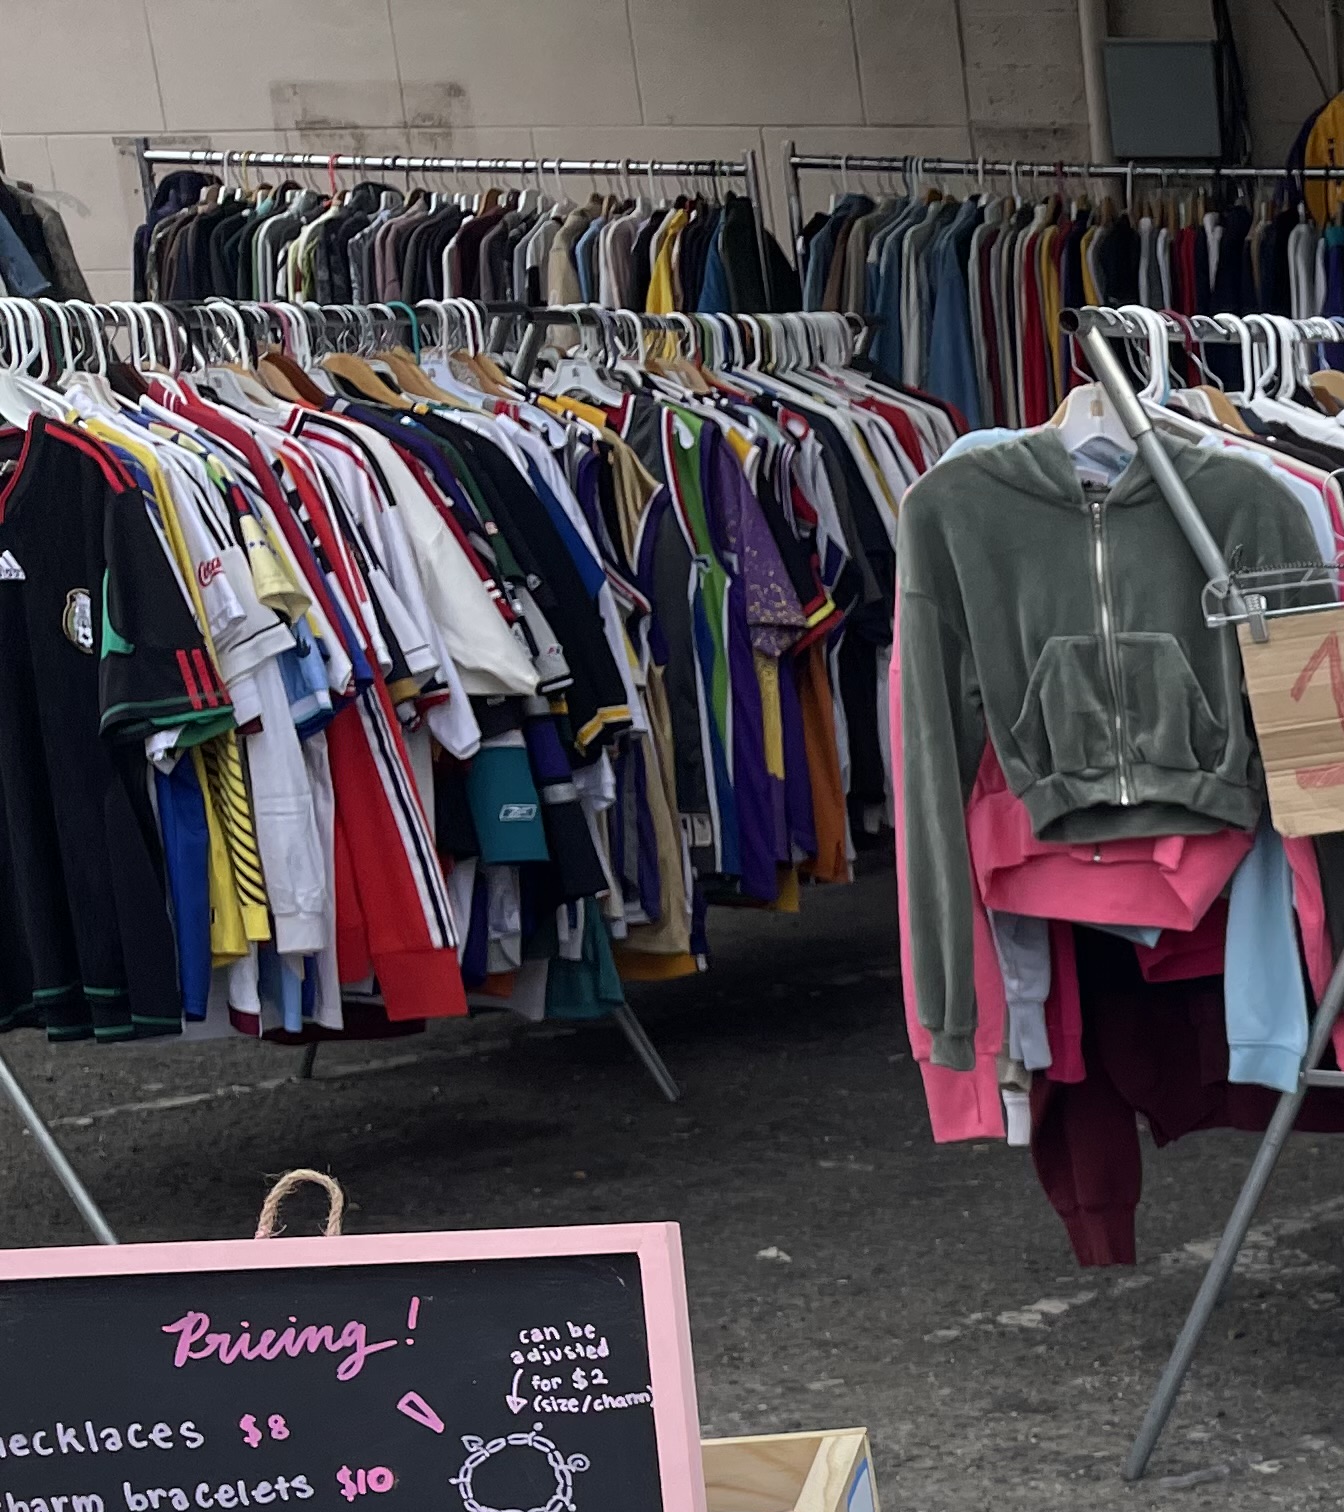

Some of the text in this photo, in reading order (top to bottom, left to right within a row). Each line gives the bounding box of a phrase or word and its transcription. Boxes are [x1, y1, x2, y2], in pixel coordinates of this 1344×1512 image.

[519, 1322, 595, 1344] can be
[511, 1337, 609, 1365] adjusted
[532, 1367, 608, 1391] for $2
[240, 1414, 289, 1447] $8
[124, 1475, 314, 1511] bracelets
[337, 1466, 394, 1501] $10
